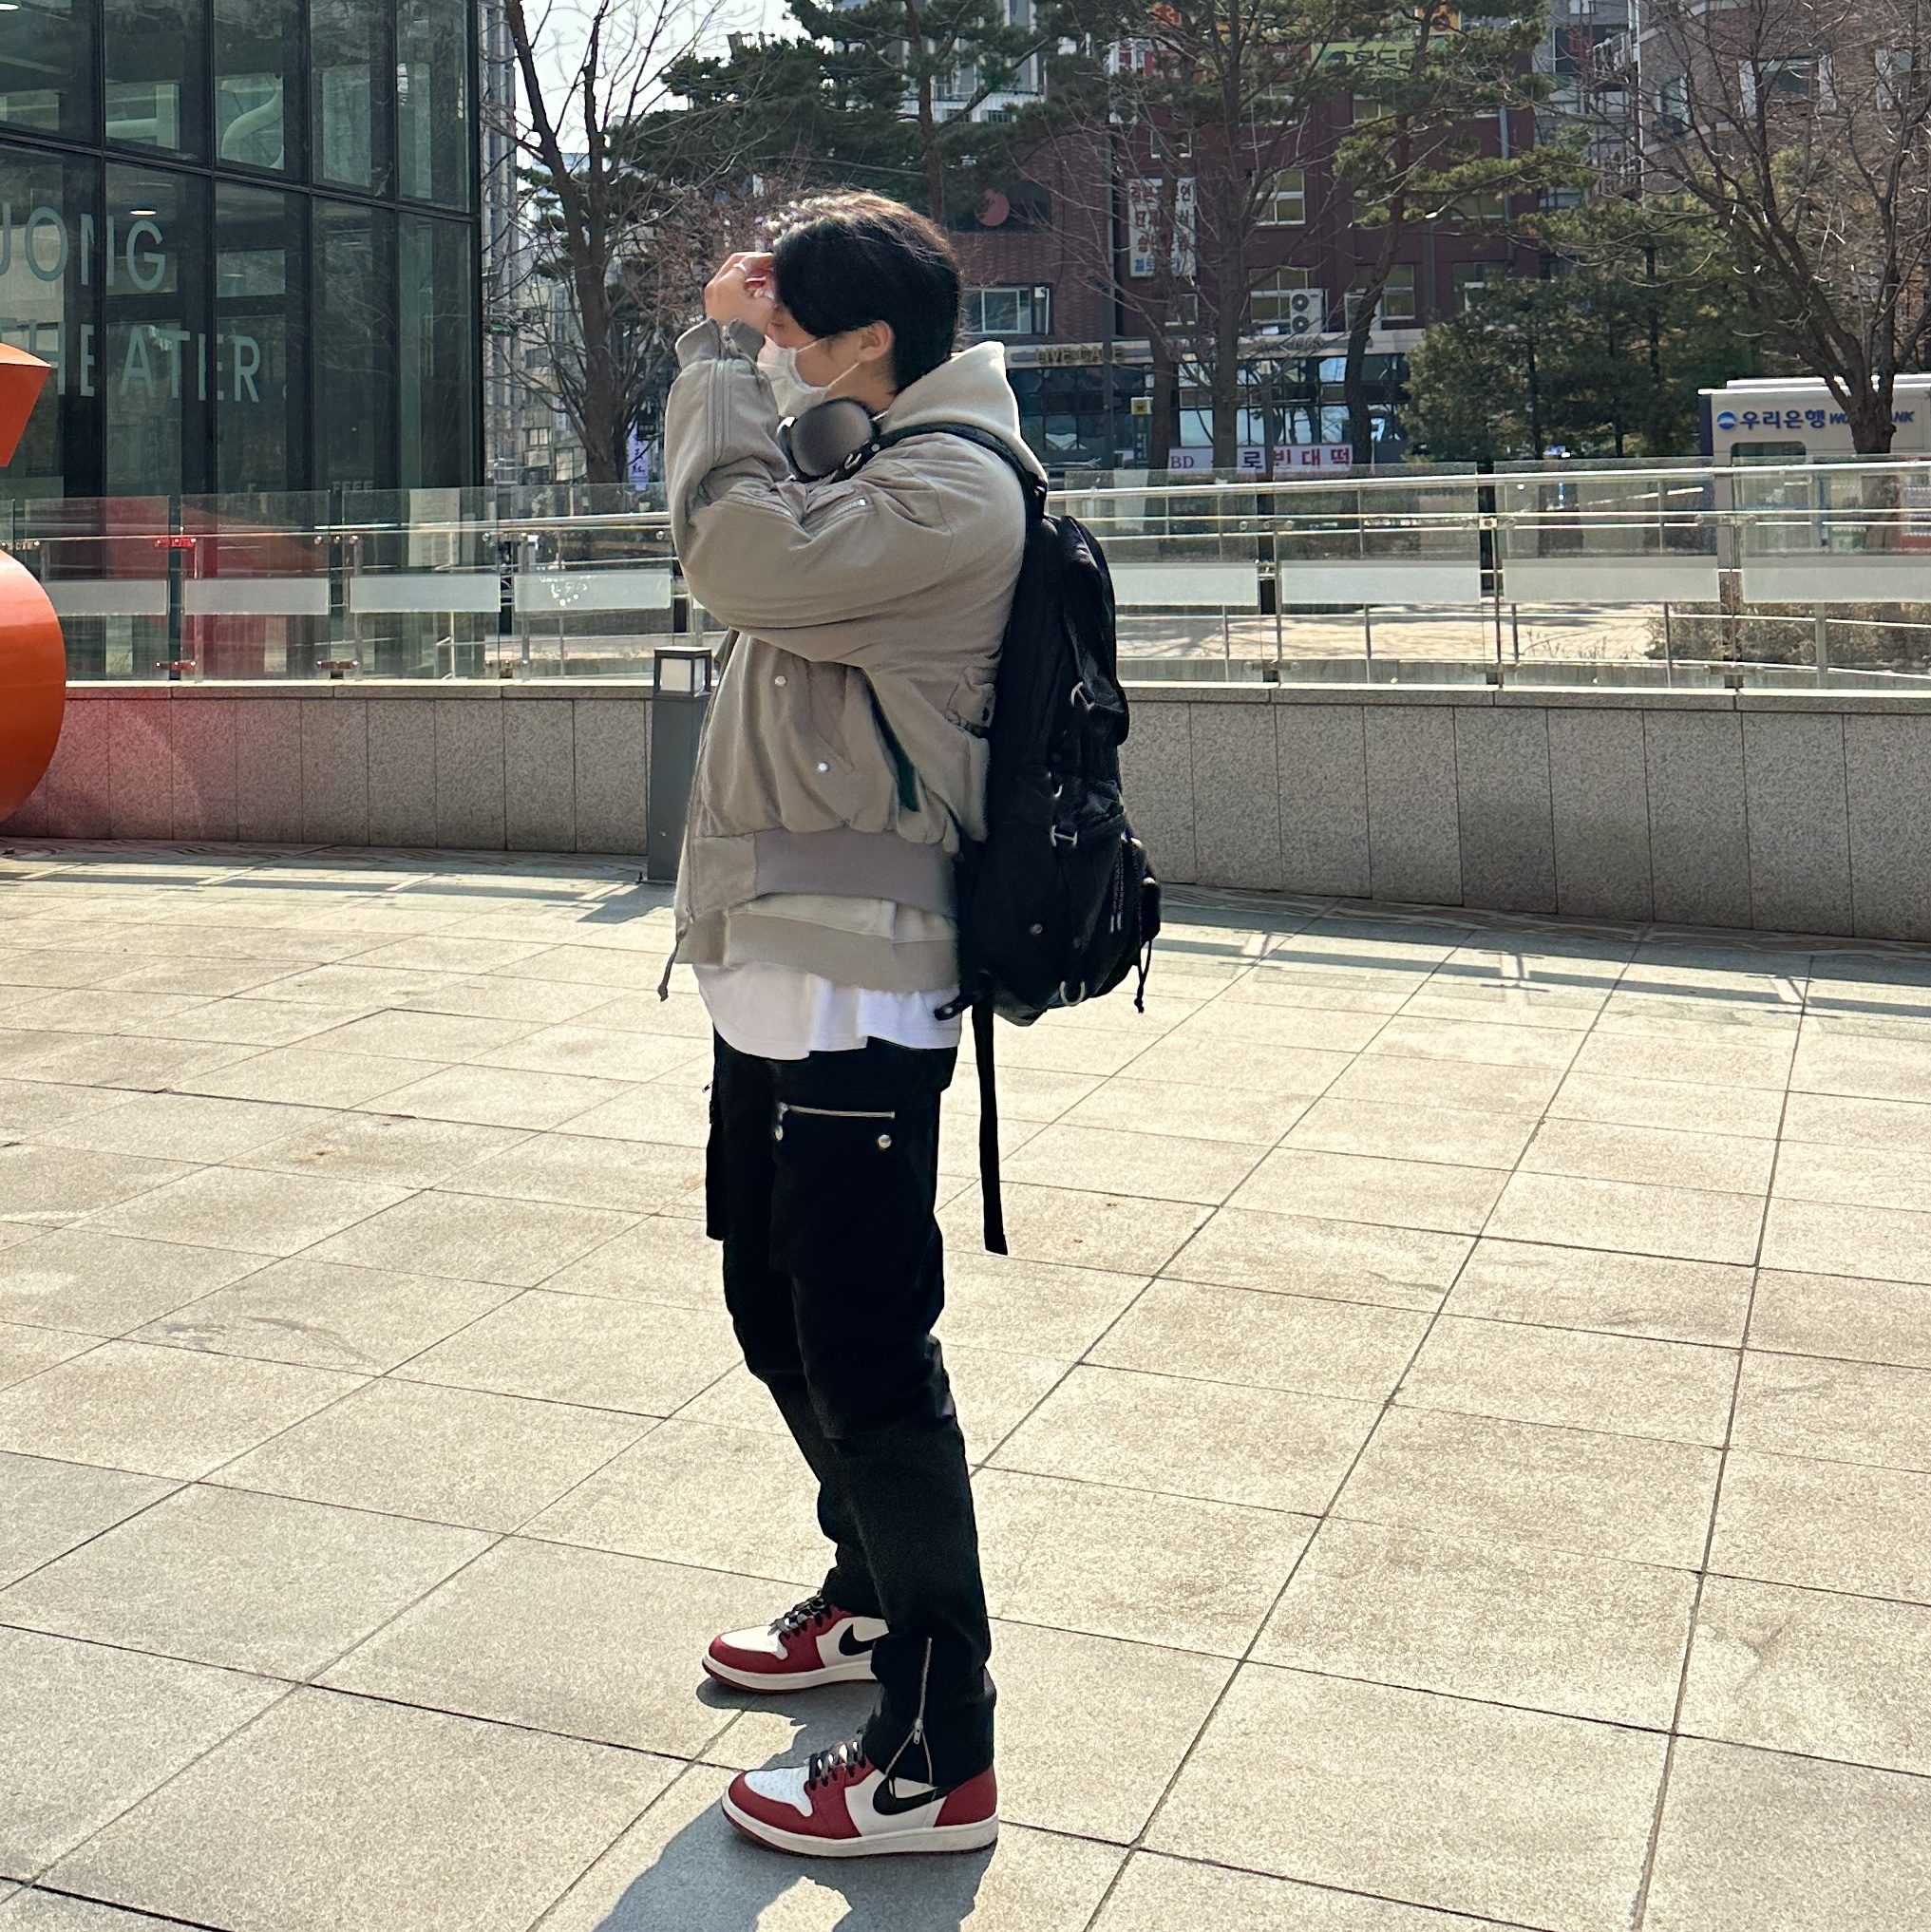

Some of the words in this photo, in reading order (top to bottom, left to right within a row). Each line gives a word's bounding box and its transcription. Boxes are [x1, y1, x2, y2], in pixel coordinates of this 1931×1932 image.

[0, 201, 166, 291] ONG
[1035, 348, 1071, 364] LIVE
[1078, 346, 1124, 364] CAE
[1739, 409, 1826, 428] 우리은행
[1171, 455, 1195, 469] BD
